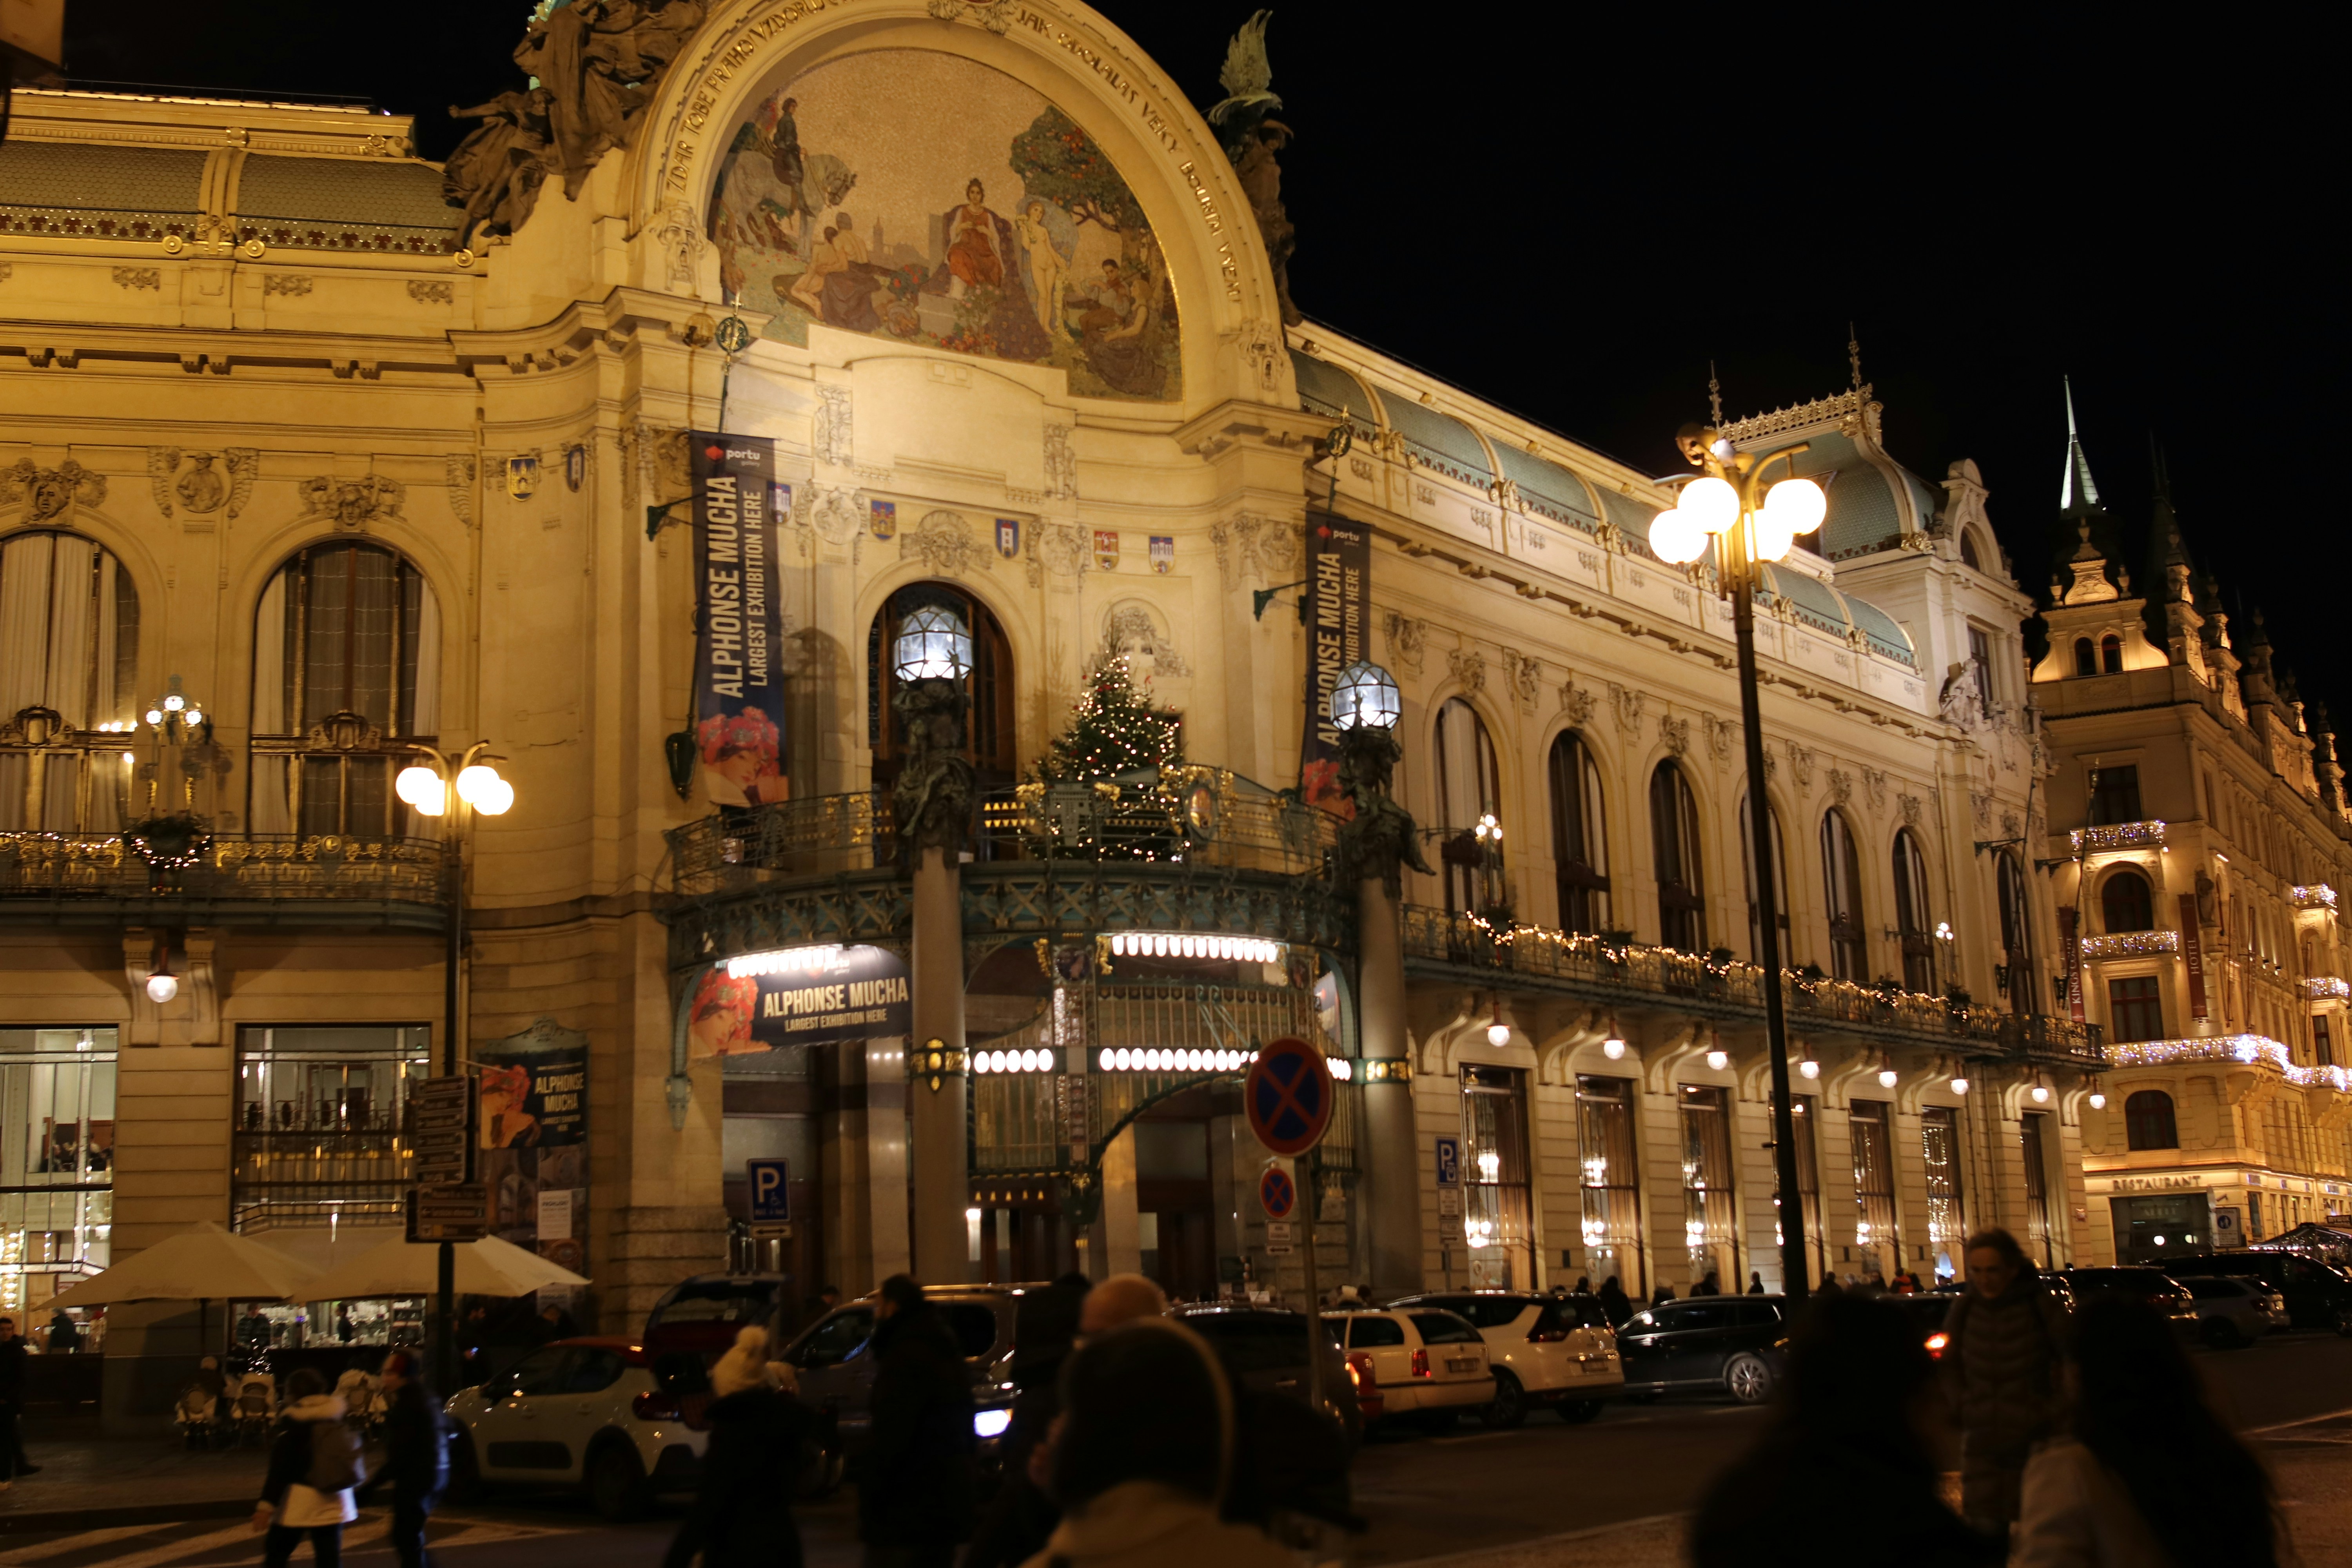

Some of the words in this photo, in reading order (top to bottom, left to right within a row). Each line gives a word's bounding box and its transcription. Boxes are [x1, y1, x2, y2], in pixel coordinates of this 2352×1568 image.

[1016, 9, 1053, 39] JAK
[726, 449, 760, 460] portu
[707, 476, 739, 563] MUCHA
[744, 491, 761, 531] HERE
[1333, 530, 1359, 541] portu
[745, 534, 765, 615] EXHIBITION
[1318, 554, 1341, 628] MUCHA
[1345, 567, 1359, 601] HERE
[709, 568, 743, 698] ALPHONSE
[748, 619, 767, 687] LARGEST
[2187, 937, 2200, 974] HOTEL
[764, 984, 845, 1018] ALPHONSE
[849, 977, 909, 1007] MUCHA
[2070, 972, 2082, 1004] KINGS
[785, 1017, 818, 1033] LARGEST
[820, 1011, 864, 1027] EXHIBITION
[867, 1009, 887, 1024] HERE
[535, 1073, 584, 1094] ALPHONSE
[544, 1093, 578, 1112] MUCHA
[1440, 1143, 1454, 1170] P
[757, 1167, 780, 1203] P
[2112, 1175, 2201, 1192] RESTAURANT
